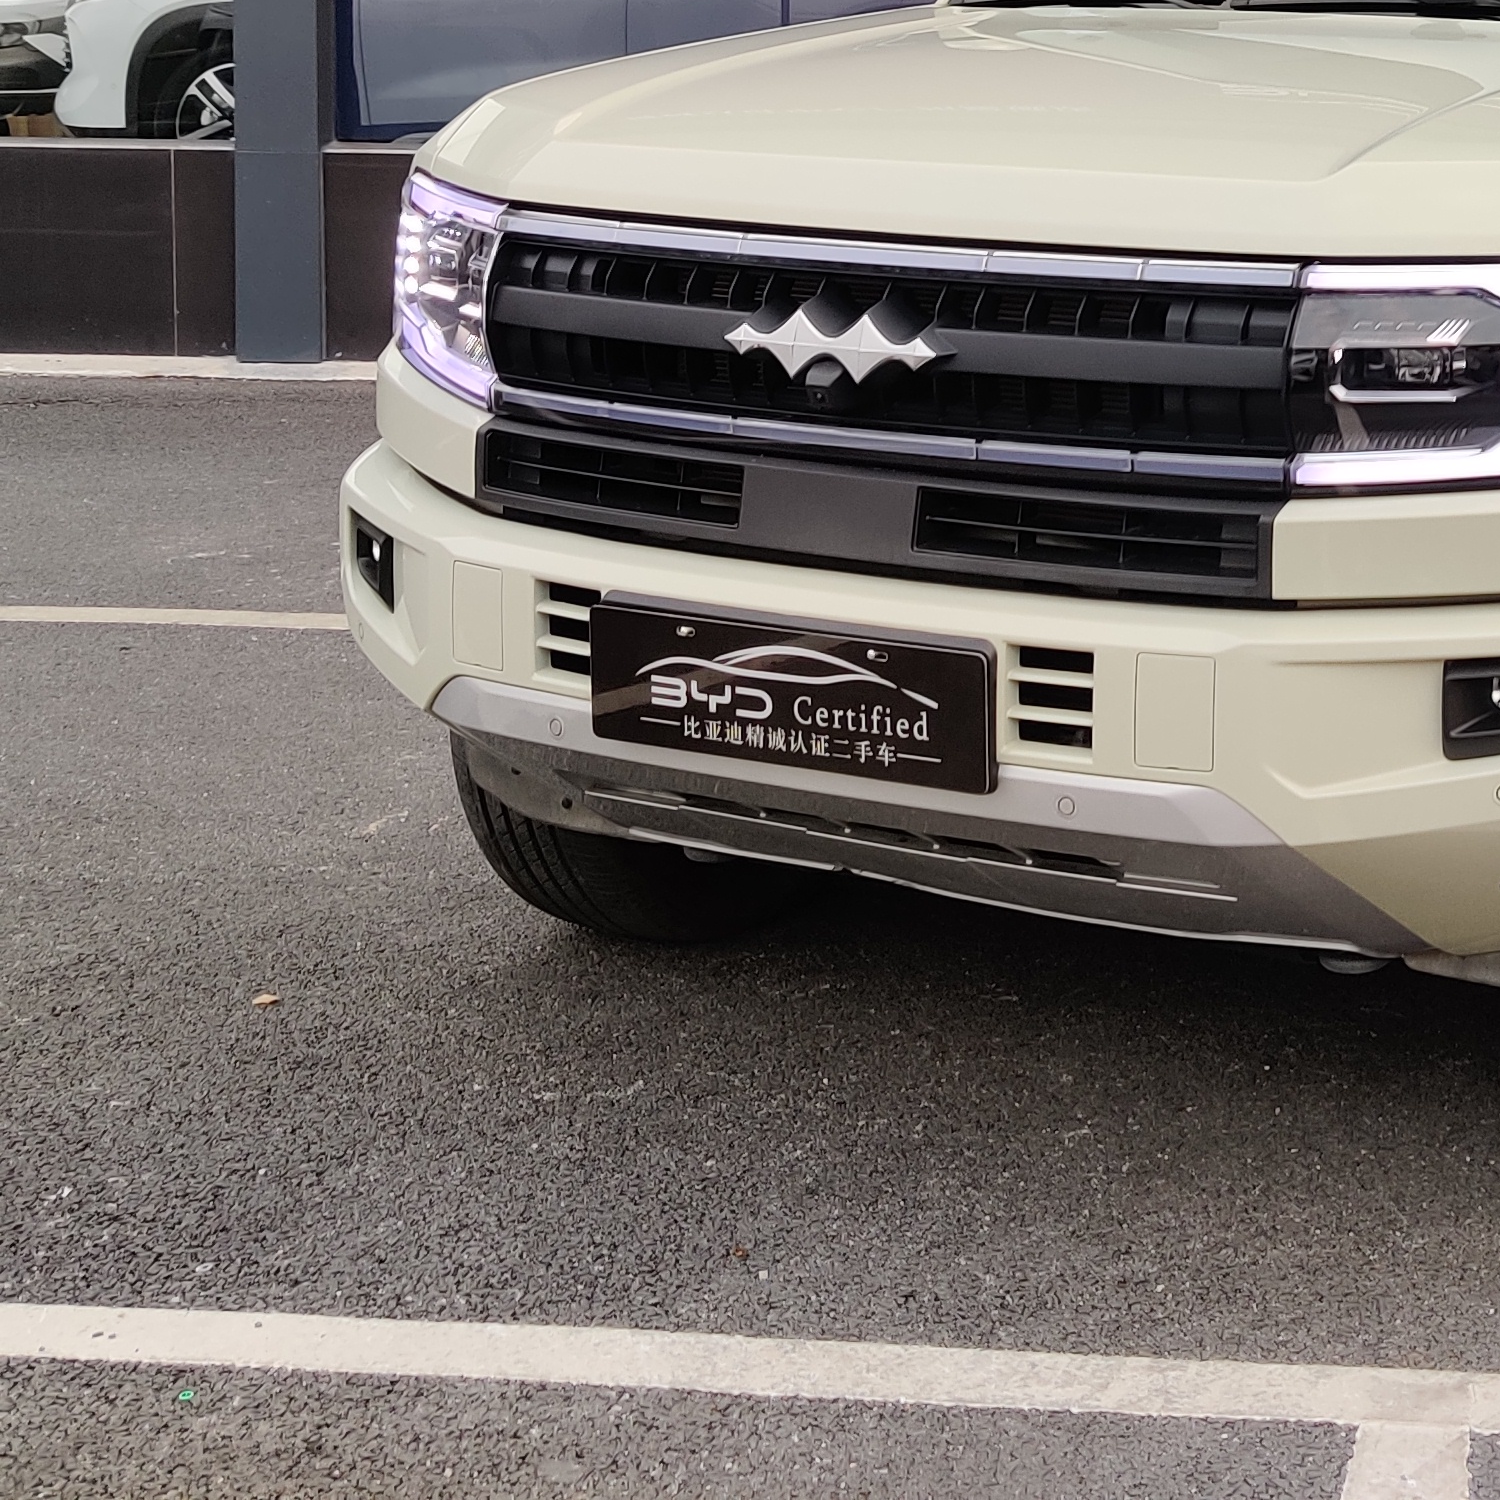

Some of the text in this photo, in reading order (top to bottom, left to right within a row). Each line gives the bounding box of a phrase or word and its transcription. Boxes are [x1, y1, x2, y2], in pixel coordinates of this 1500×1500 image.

[650, 673, 930, 742] BYD Certified
[682, 714, 897, 767] 比亚迪精诚认证二手车
